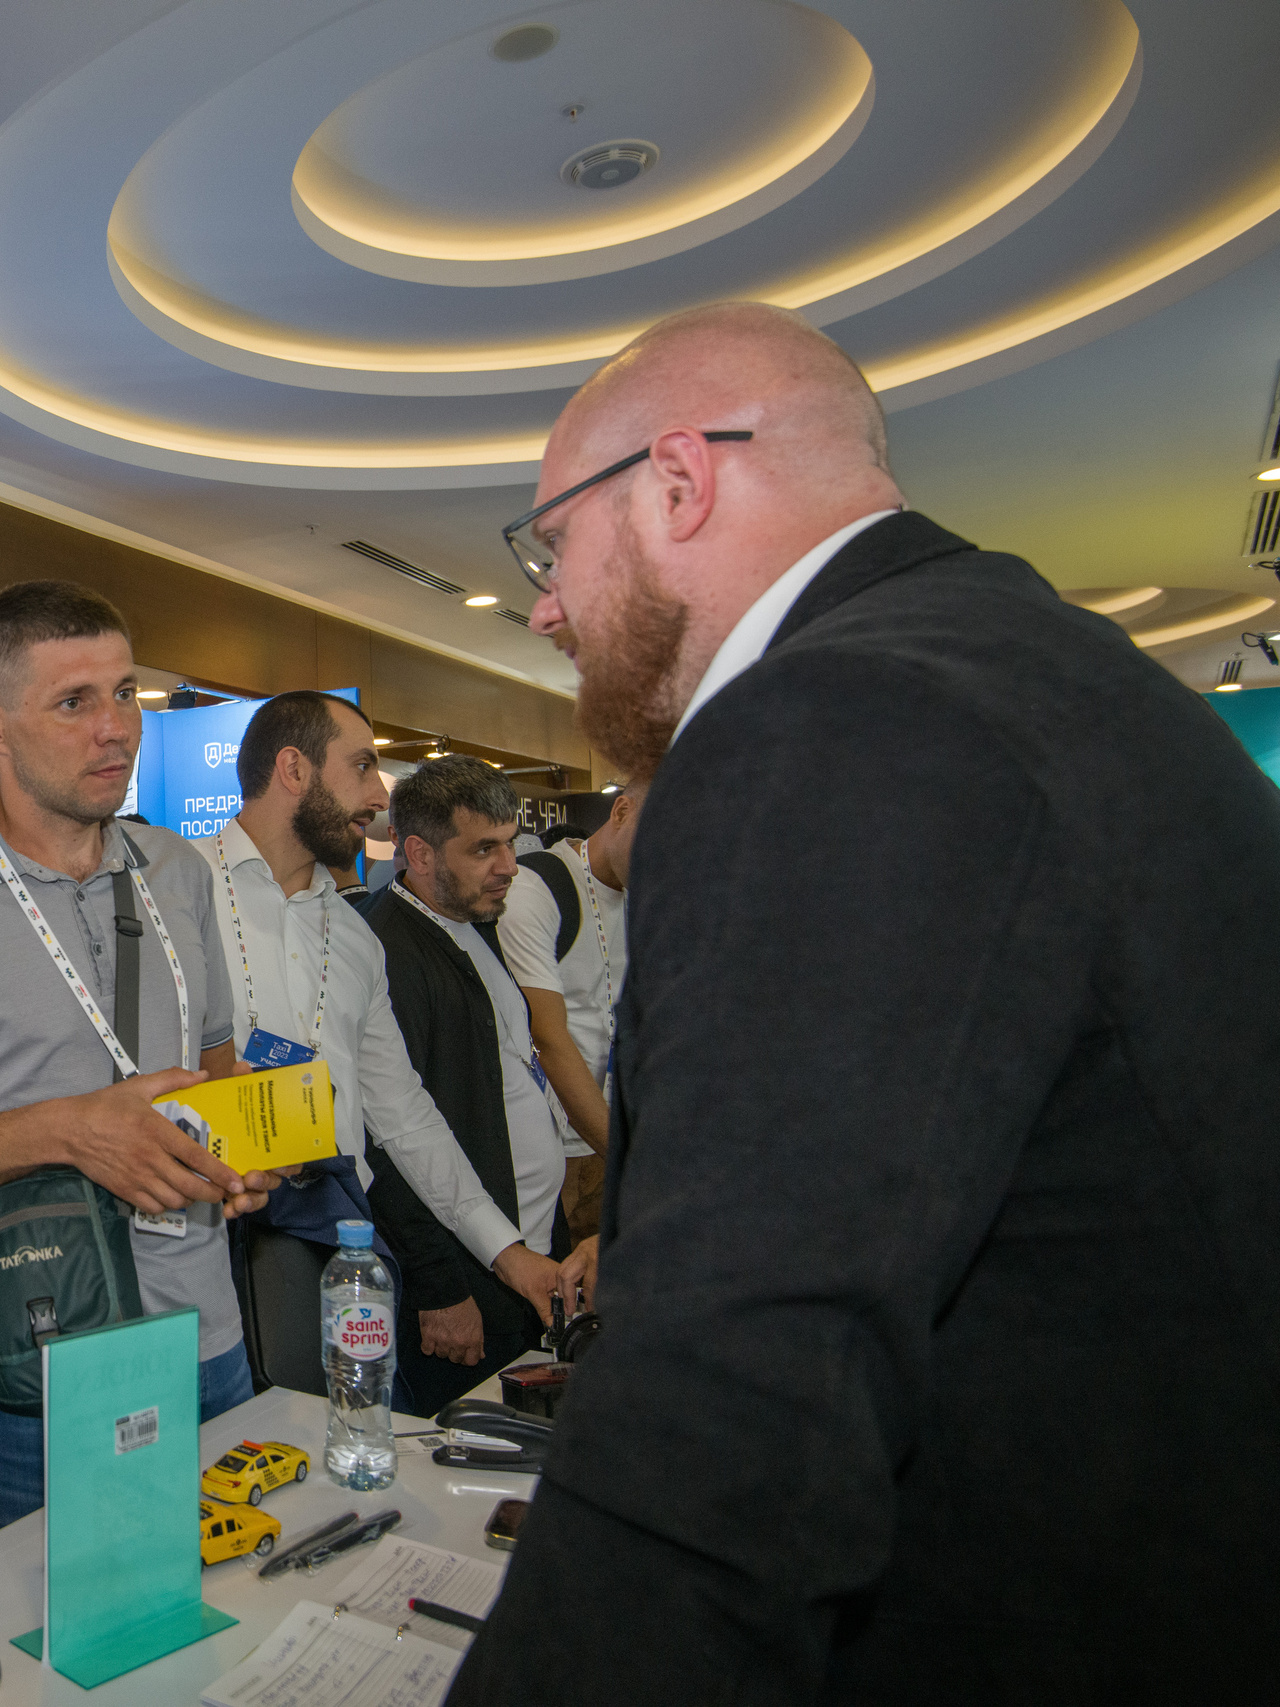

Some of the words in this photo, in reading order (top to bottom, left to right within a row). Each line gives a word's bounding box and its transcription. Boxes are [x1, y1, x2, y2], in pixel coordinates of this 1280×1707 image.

[223, 743, 242, 757] Де
[273, 1041, 287, 1052] Taxi
[273, 1049, 289, 1060] 2023
[260, 1056, 282, 1067] УЧАСТ
[346, 1318, 385, 1332] saint
[341, 1332, 388, 1348] spring
